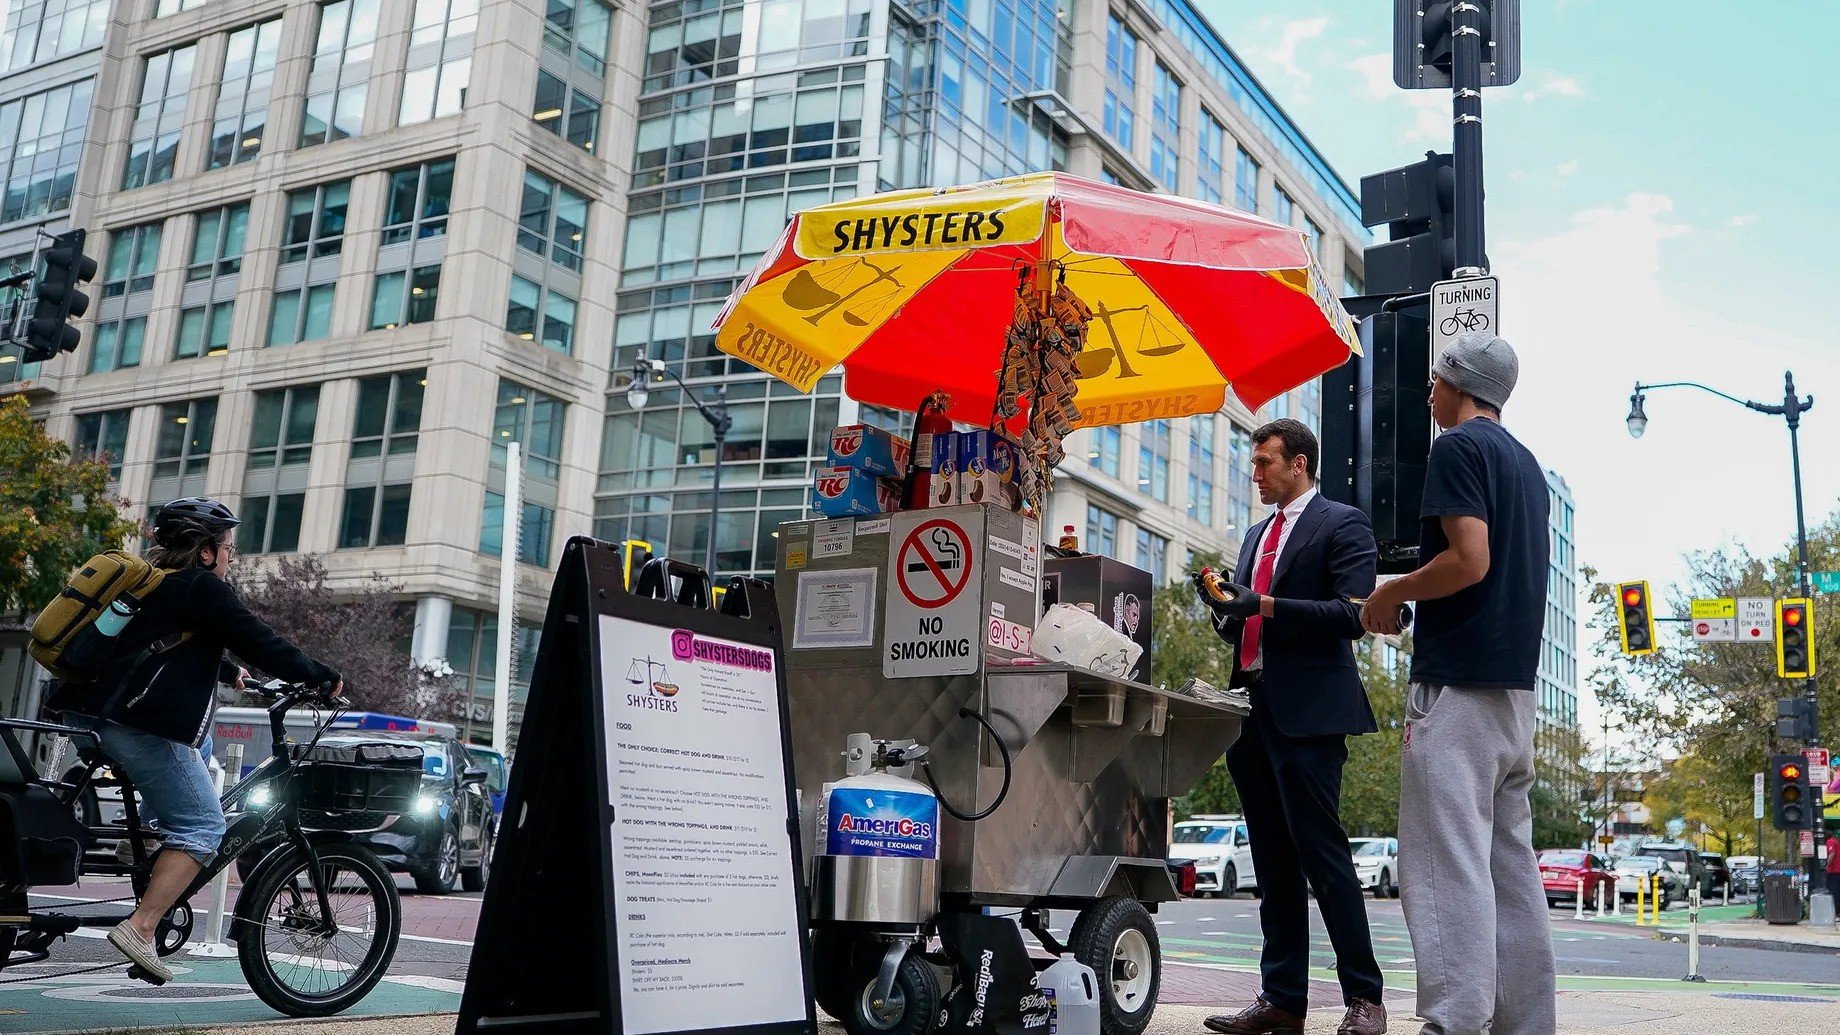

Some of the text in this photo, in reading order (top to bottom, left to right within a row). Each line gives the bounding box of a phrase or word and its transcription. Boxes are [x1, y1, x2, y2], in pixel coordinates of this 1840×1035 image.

[833, 209, 1006, 253] SHYSTERS
[1440, 287, 1491, 305] TURNING
[831, 436, 863, 456] RC
[816, 478, 849, 497] RC
[824, 542, 842, 552] 10796
[1748, 602, 1763, 610] NO
[918, 616, 943, 635] NO
[692, 638, 772, 673] SHYSTERSDOGS
[890, 638, 970, 661] SMOKING
[626, 694, 678, 714] SHYSTERS
[838, 813, 931, 838] AmeriGas
[851, 838, 922, 851] PROPANE EXCHANGE
[1020, 993, 1048, 1012] Shop
